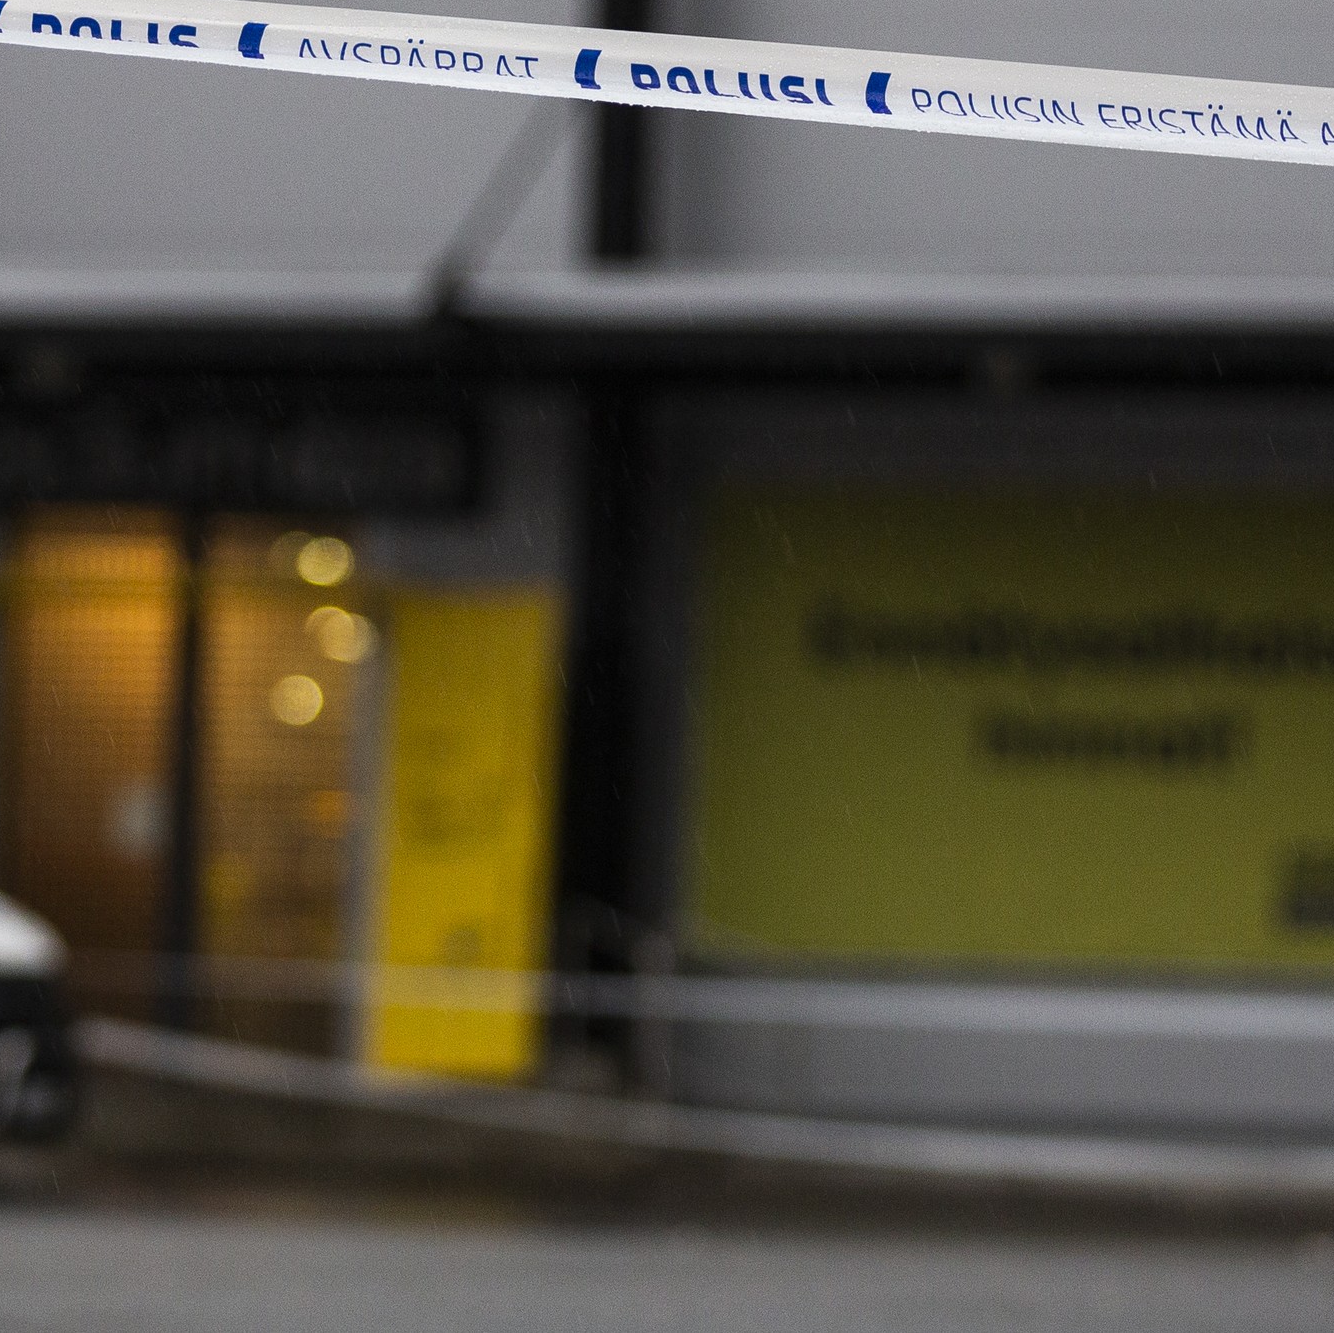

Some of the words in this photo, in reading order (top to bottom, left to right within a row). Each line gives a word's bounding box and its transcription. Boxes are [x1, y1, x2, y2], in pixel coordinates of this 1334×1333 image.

[630, 63, 835, 107] POLIISI
[910, 88, 1083, 127] POLIISIN
[1098, 103, 1305, 144] ERISTÄMÄ
